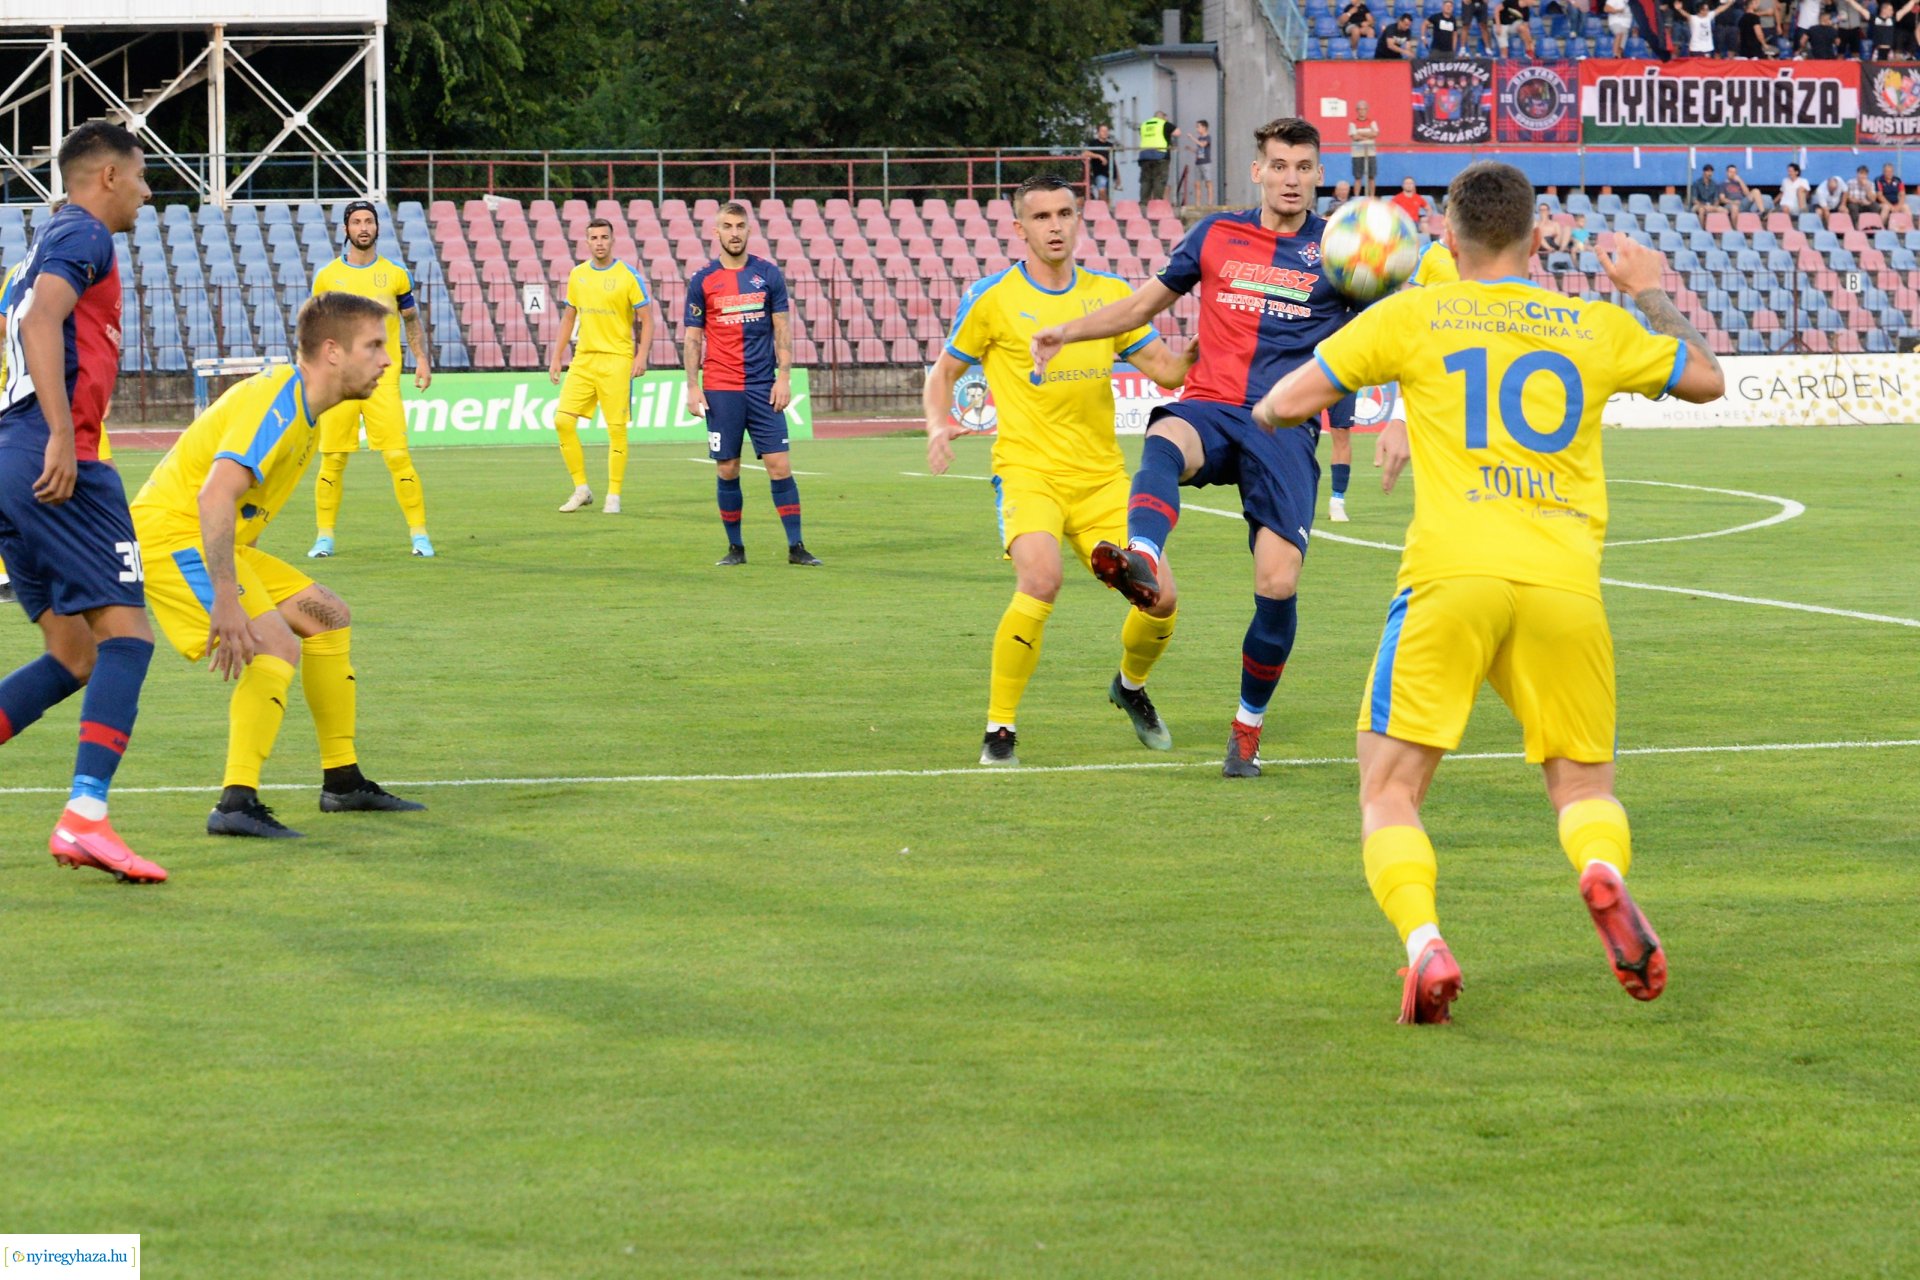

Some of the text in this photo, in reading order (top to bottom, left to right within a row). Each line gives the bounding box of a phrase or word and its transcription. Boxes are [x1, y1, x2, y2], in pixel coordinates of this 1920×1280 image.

[1413, 62, 1490, 82] NYÍREGYHÁZA
[1597, 67, 1842, 126] NYÍREGYHÁZA
[1218, 260, 1320, 292] REVESZ
[1850, 274, 1858, 290] B
[529, 296, 541, 311] A
[1437, 298, 1580, 325] KOLORCITY
[1430, 319, 1595, 340] KAZINCBARCIKA SC
[1111, 378, 1163, 400] SIK
[1738, 374, 1903, 401] GARDEN
[1443, 347, 1584, 454] 10
[1663, 409, 1708, 421] HOTEL
[1479, 460, 1546, 499] TÓTH
